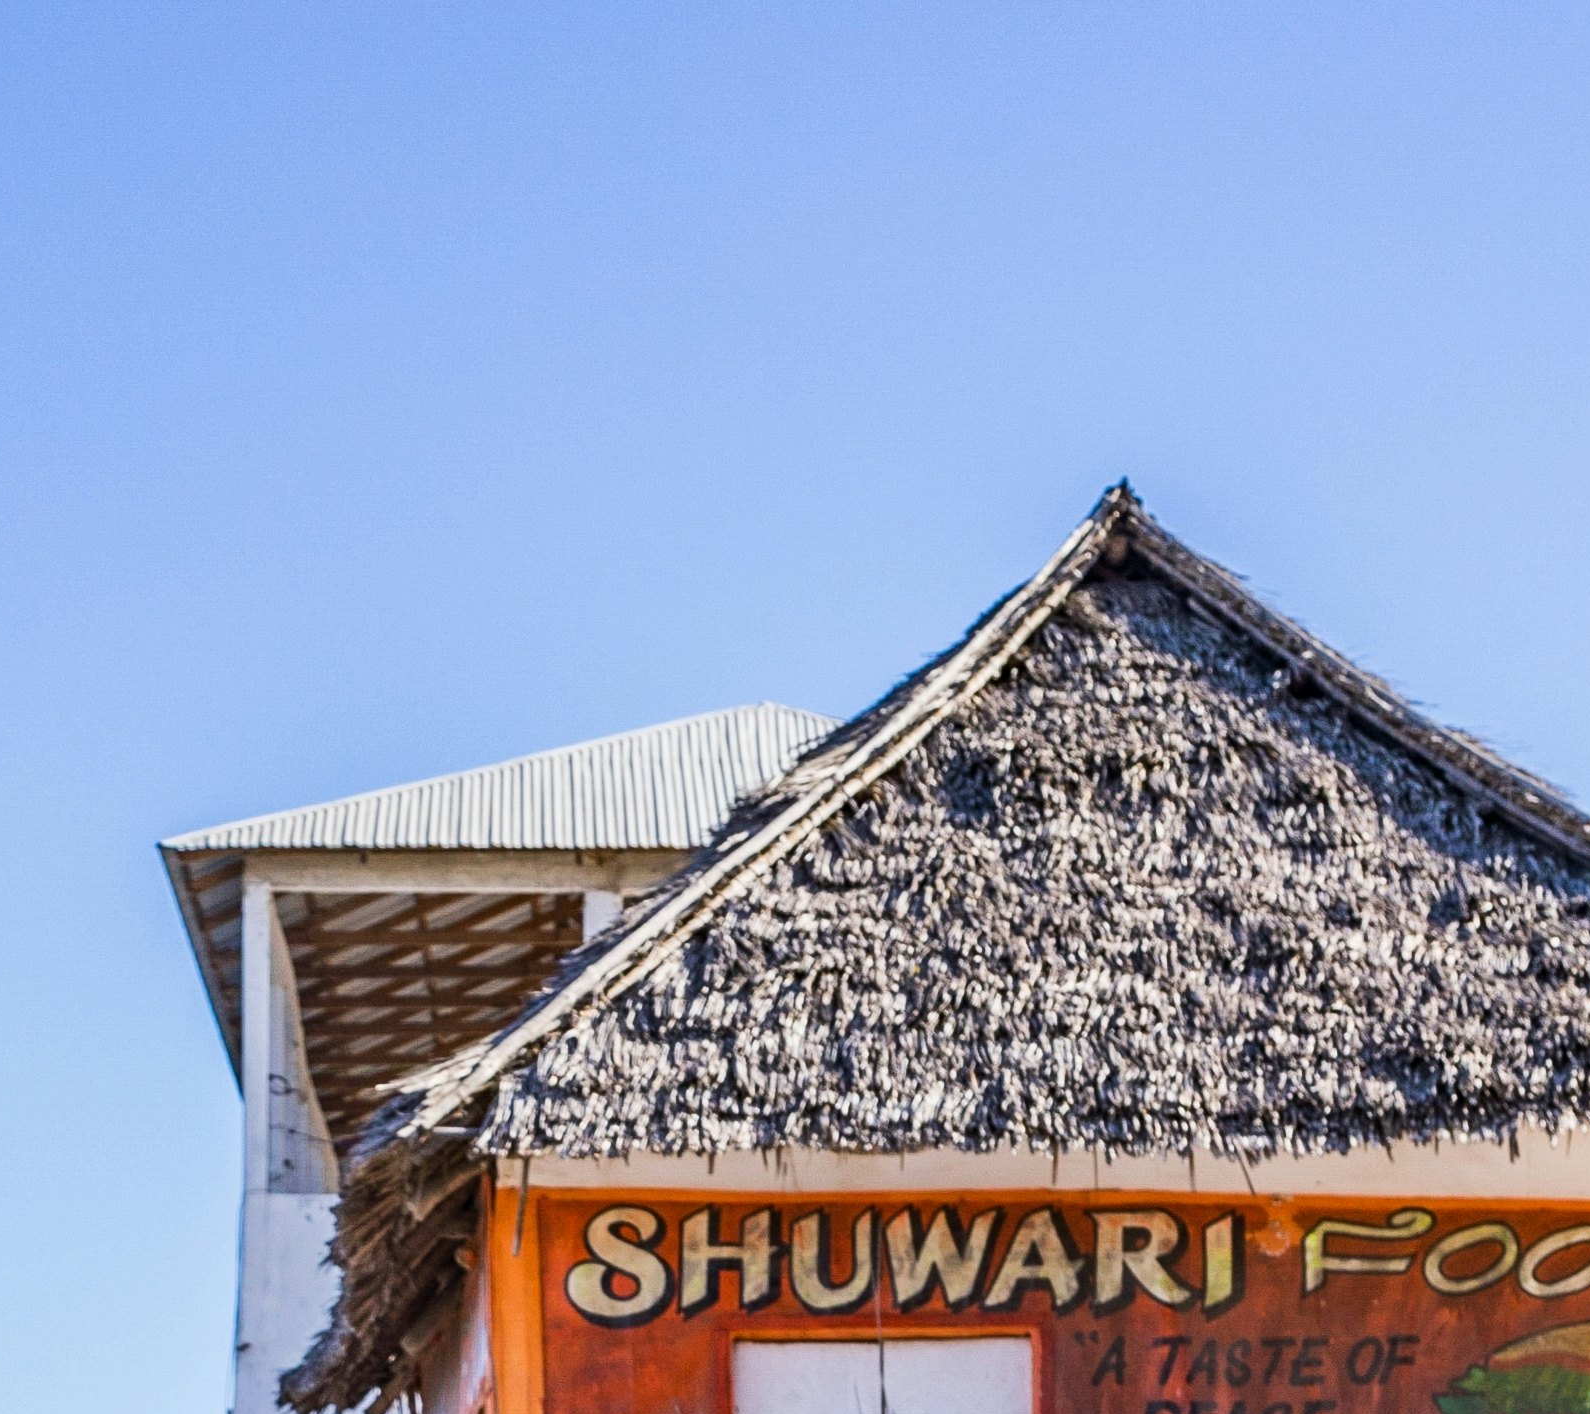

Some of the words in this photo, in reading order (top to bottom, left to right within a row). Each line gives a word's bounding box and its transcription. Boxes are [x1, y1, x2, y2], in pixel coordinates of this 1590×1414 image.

[565, 1204, 1242, 1322] SHUWARI
[1155, 1335, 1327, 1386] TASTE
[1346, 1335, 1420, 1386] OF
